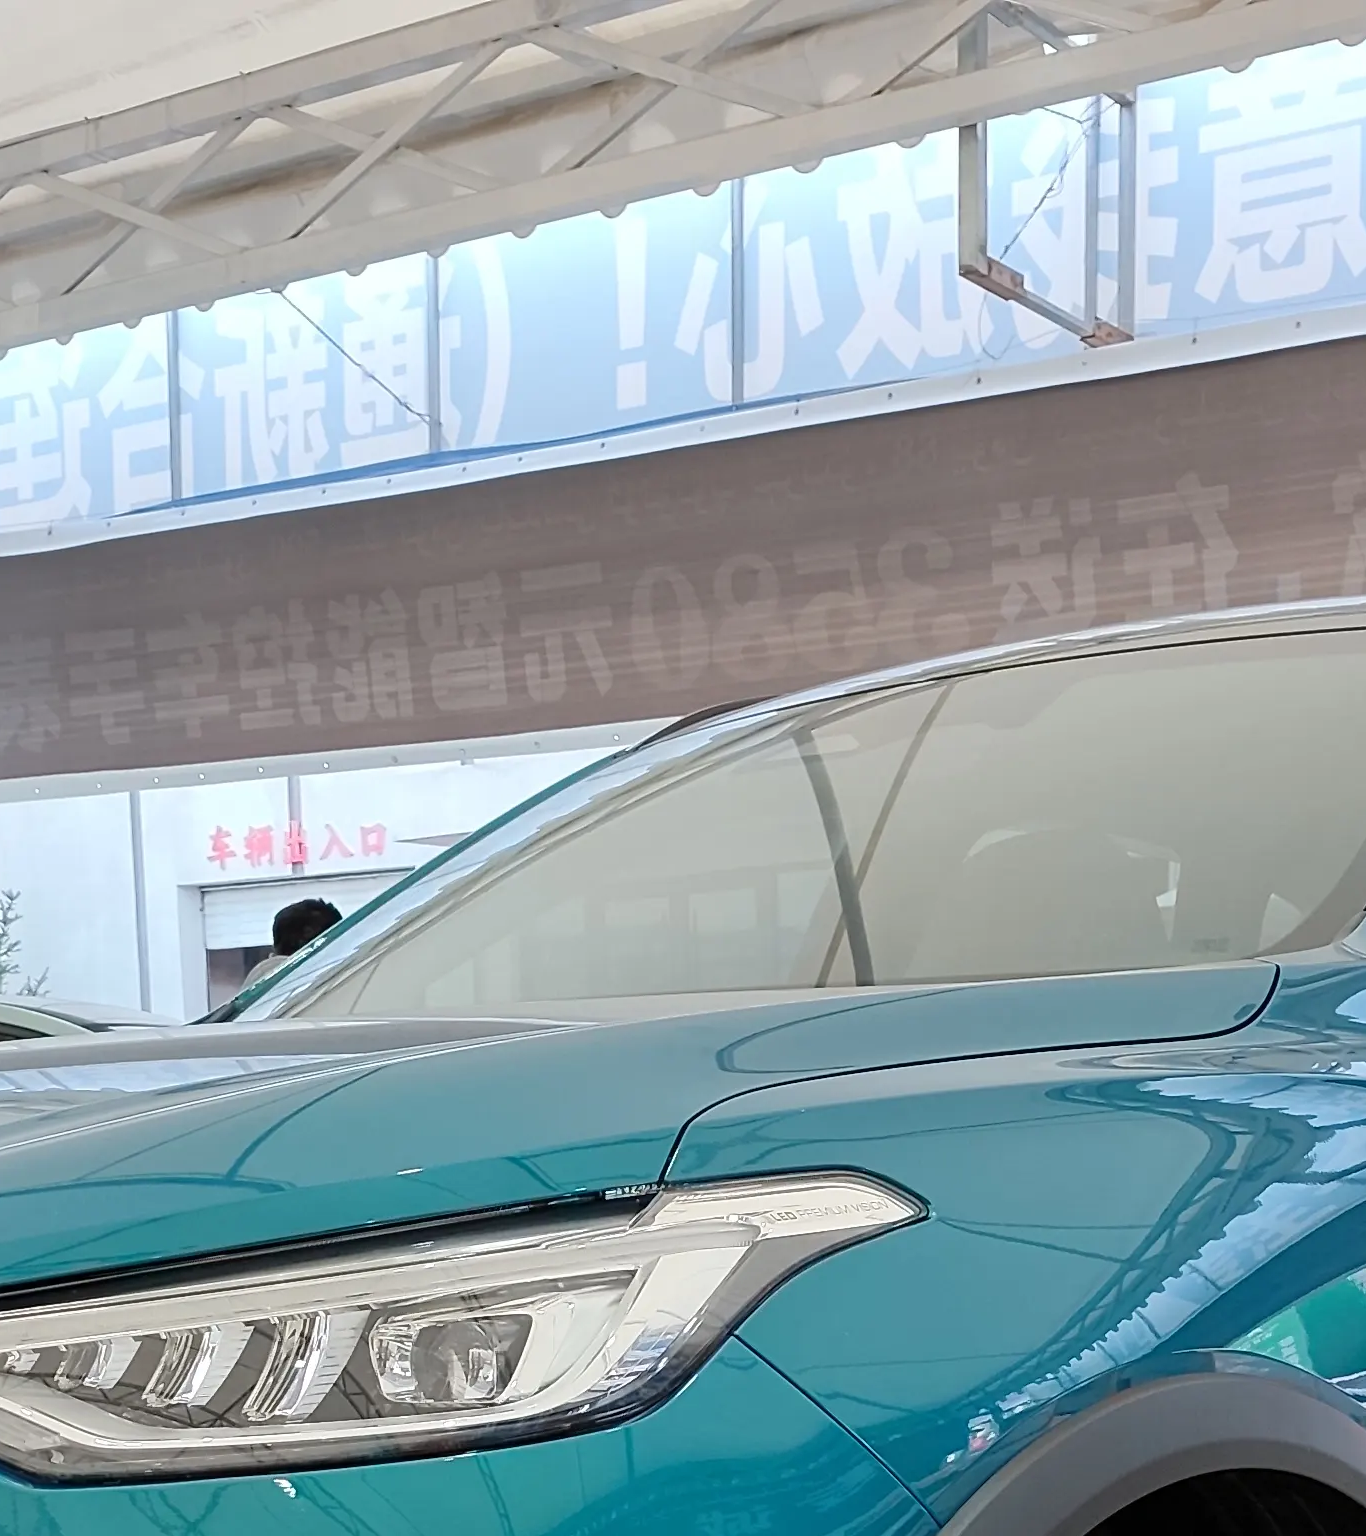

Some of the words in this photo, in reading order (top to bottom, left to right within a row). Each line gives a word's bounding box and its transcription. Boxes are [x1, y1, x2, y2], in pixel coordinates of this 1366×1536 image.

[207, 821, 388, 871] 车辆出入口
